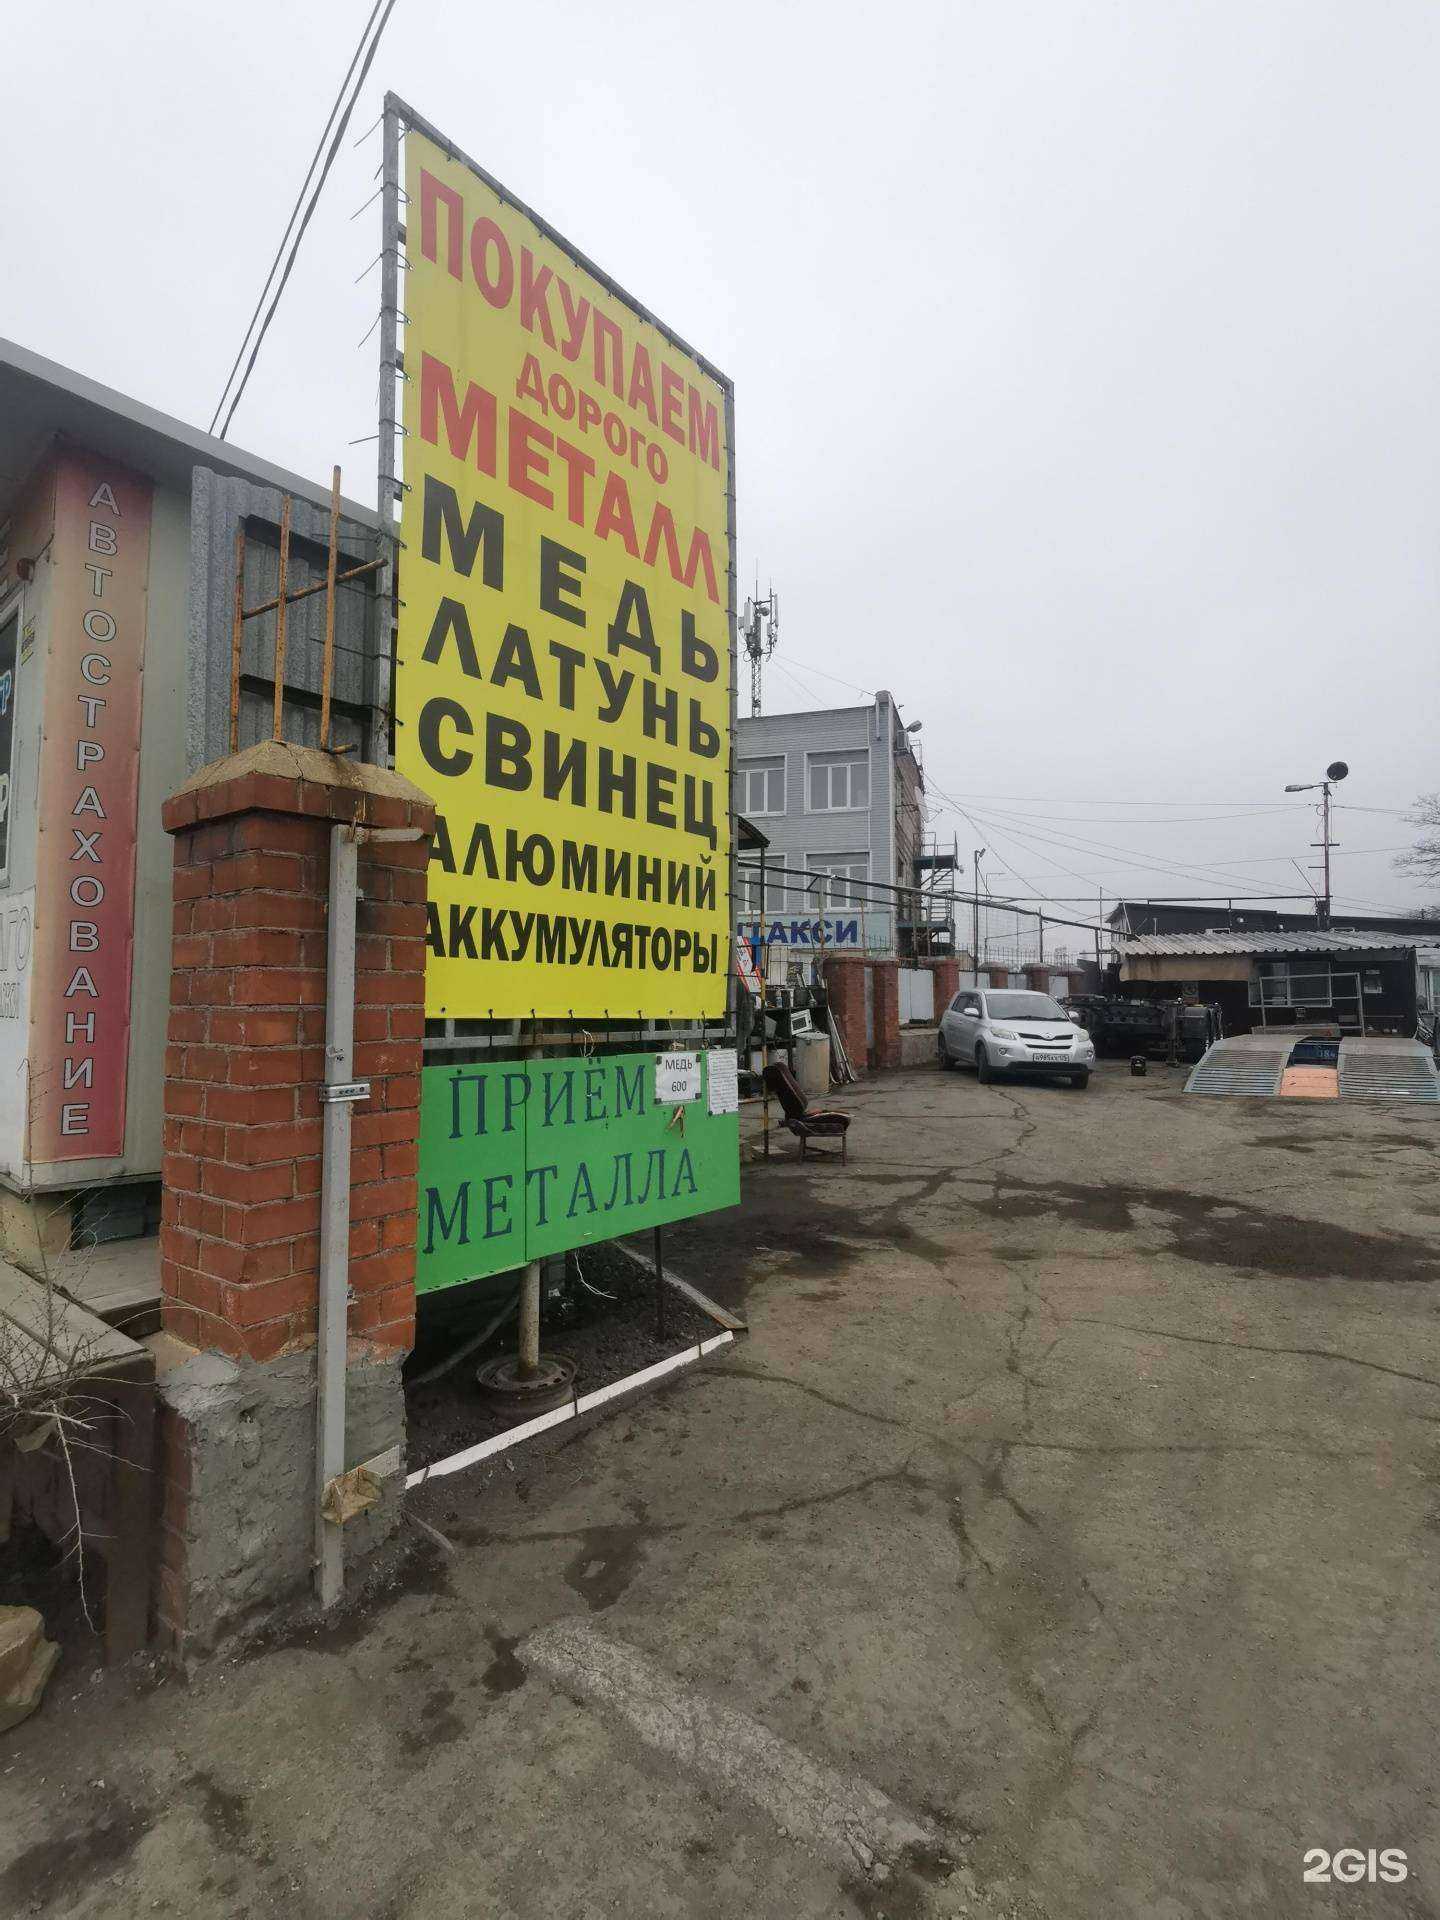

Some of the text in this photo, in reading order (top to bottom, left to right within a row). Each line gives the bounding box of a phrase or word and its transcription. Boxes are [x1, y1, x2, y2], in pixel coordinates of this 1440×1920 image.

[420, 166, 720, 472] ПОКУПАЕМ
[420, 349, 721, 606] МЕТАЛЛ
[515, 351, 669, 486] ДОРОГО
[421, 472, 720, 684] МЕДЬ
[421, 596, 721, 759] ЛАТУНЬ
[61, 481, 122, 1136] АВТОСТРАХОВАНИЕ
[418, 696, 718, 852] СВИНЕЦ
[428, 814, 717, 912] АЛЮМИНИЙ
[425, 900, 718, 975] АККУМУЛЯТОРЫ
[448, 1058, 647, 1139] ПРИЁМ
[665, 1058, 693, 1072] МЕДЬ
[671, 1080, 687, 1092] 600
[422, 1147, 699, 1254] МЕТАЛЛА
